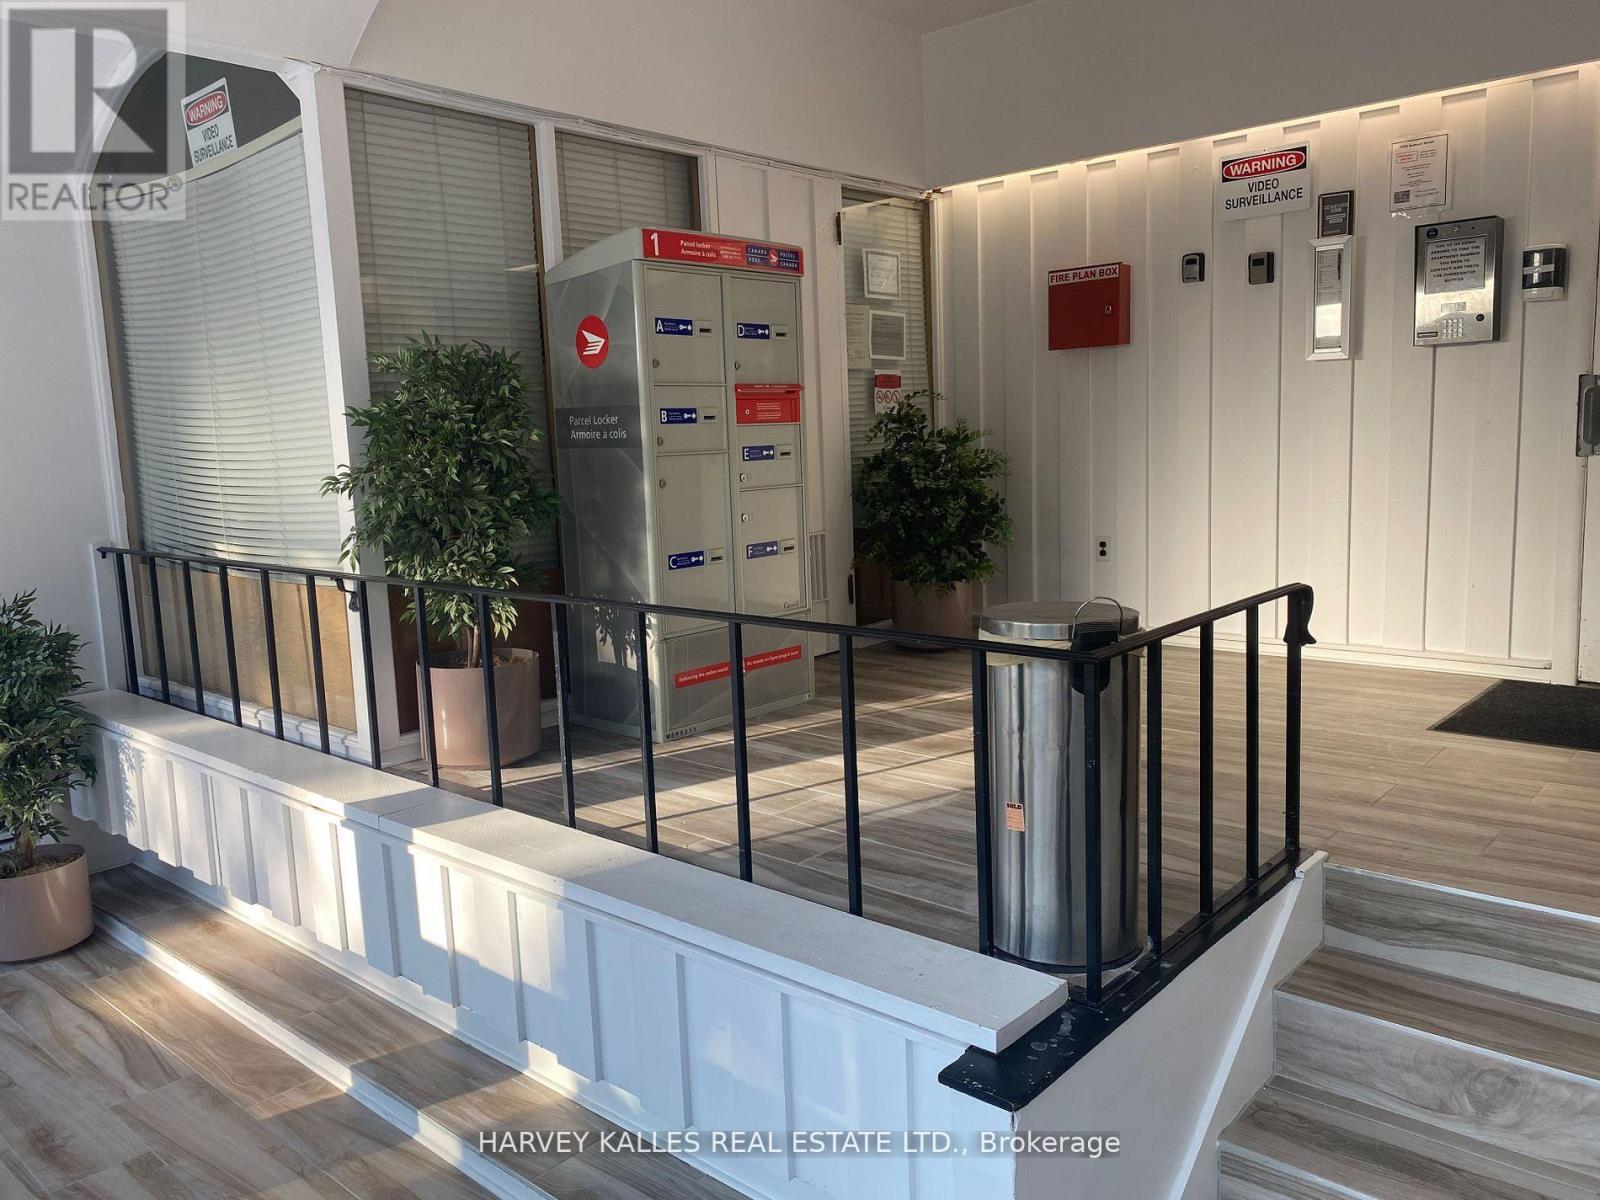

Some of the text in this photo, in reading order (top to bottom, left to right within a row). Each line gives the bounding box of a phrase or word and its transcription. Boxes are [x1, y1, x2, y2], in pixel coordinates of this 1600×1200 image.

[188, 95, 224, 122] WARNING
[201, 124, 219, 141] VIDEO
[193, 134, 234, 163] SURVEILLANCE
[1230, 154, 1297, 176] WARNING
[1248, 178, 1279, 193] VIDEO
[1225, 187, 1303, 210] SURVEILLANCE
[650, 232, 659, 256] 1
[1050, 267, 1118, 283] FIRE PLAN BOX
[656, 320, 664, 333] A
[737, 324, 745, 337] D
[569, 414, 619, 426] Parcel Locker
[661, 410, 668, 423] B
[570, 428, 627, 440] Armoire à colis
[743, 448, 750, 460] E
[748, 546, 753, 557] F
[669, 555, 677, 568] C
[1006, 802, 1022, 810] SOLD
